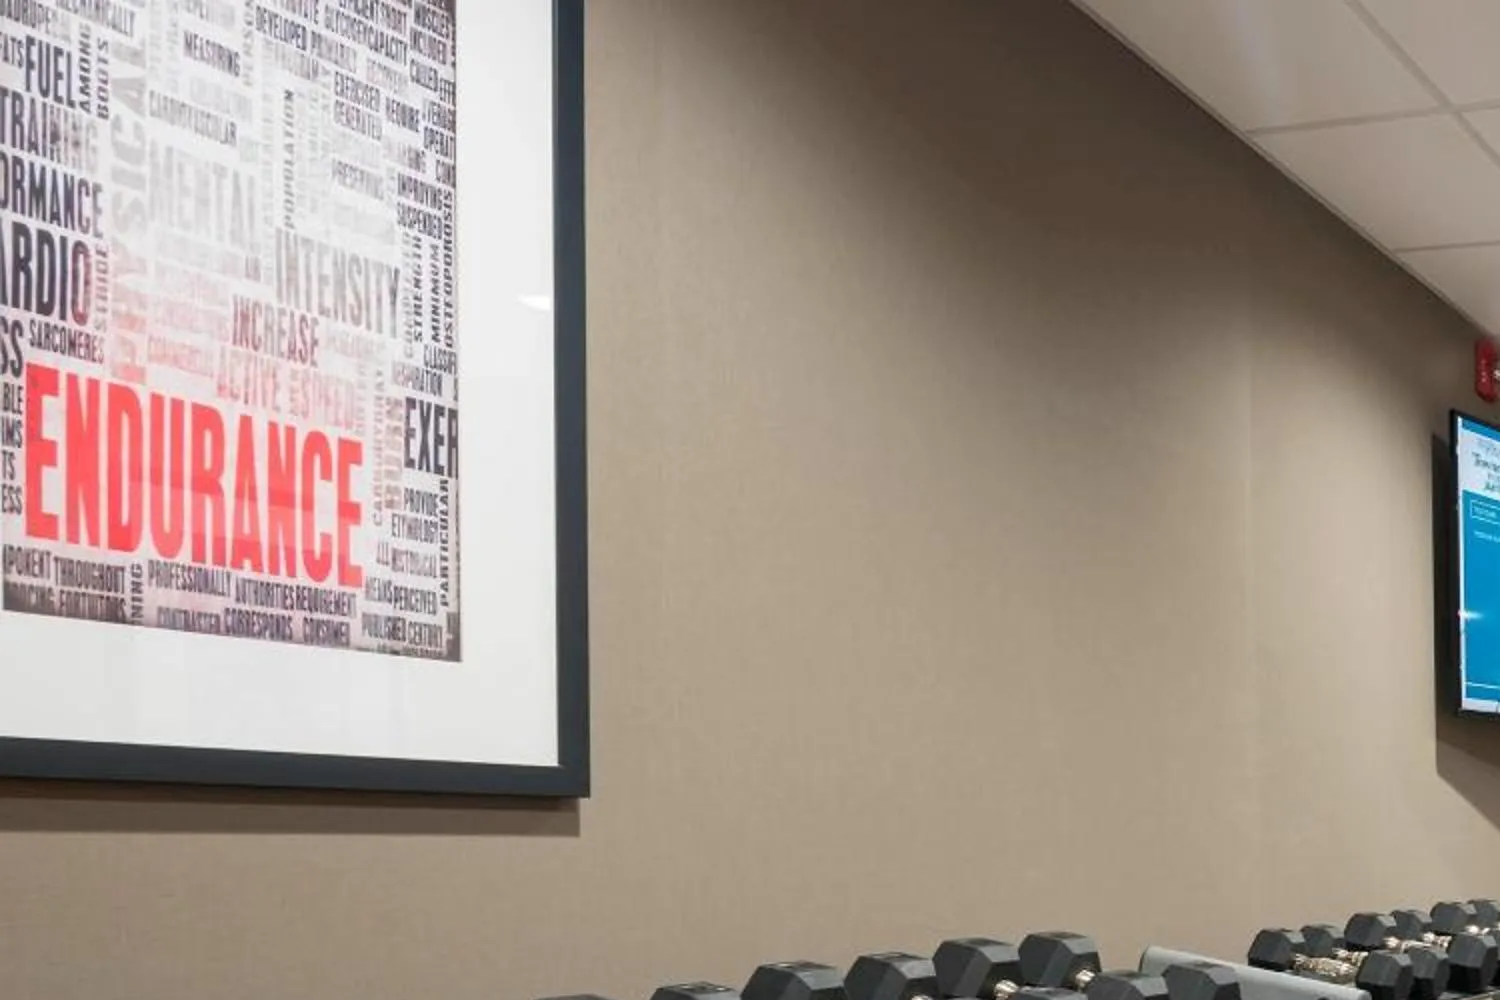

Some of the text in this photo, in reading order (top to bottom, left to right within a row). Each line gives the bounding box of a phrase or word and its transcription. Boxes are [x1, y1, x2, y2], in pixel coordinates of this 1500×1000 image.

[25, 36, 75, 107] FUEL
[275, 228, 400, 337] INTENSITY
[231, 295, 319, 368] INCREASE
[25, 363, 363, 588] ENDURANCE
